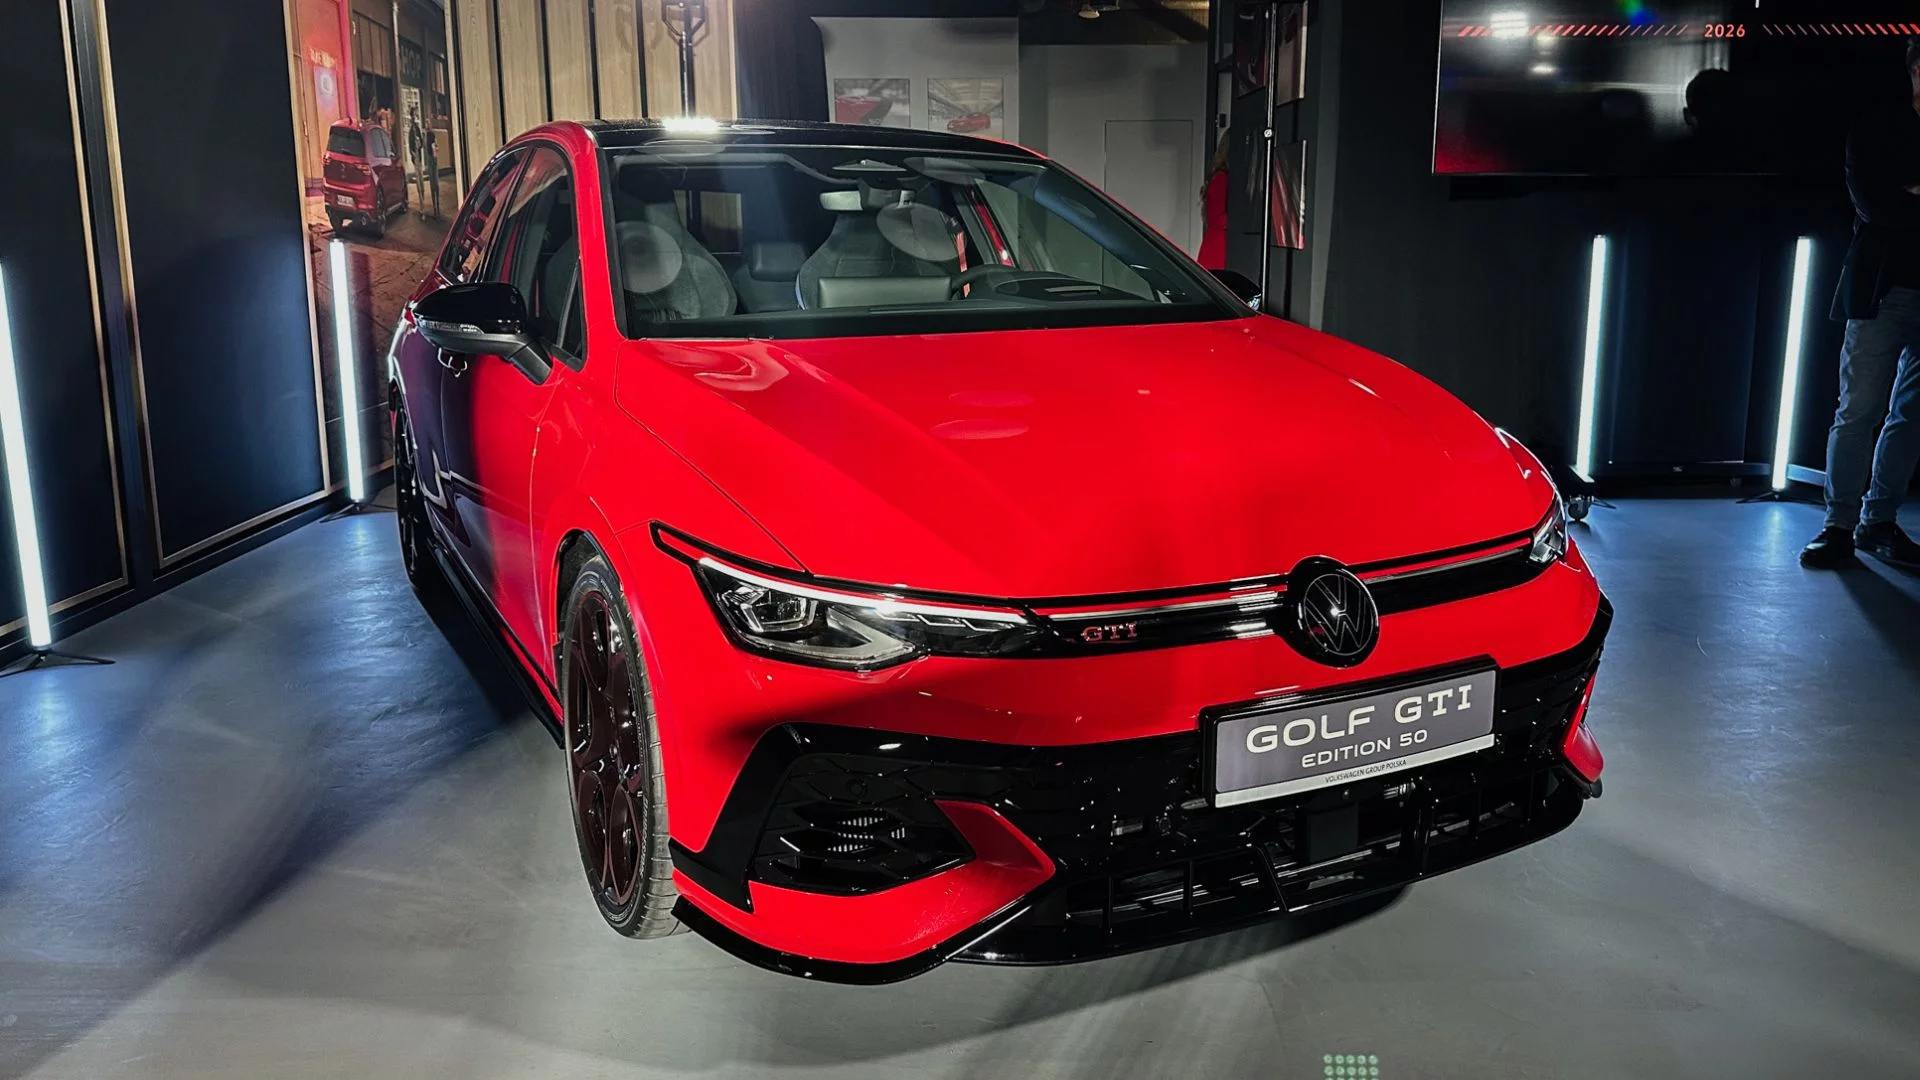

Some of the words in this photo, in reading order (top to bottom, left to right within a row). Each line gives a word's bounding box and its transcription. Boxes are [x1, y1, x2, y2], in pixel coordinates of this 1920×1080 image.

[1704, 24, 1746, 38] 2026
[1081, 622, 1138, 641] GTI
[1246, 705, 1375, 754] GOLF
[1394, 684, 1472, 724] GTI
[1301, 737, 1391, 769] EDITION
[1399, 729, 1428, 748] 50
[1325, 769, 1364, 783] VOLKSWAGEN
[1365, 764, 1386, 775] GROUP
[1386, 759, 1407, 770] POLSKA
